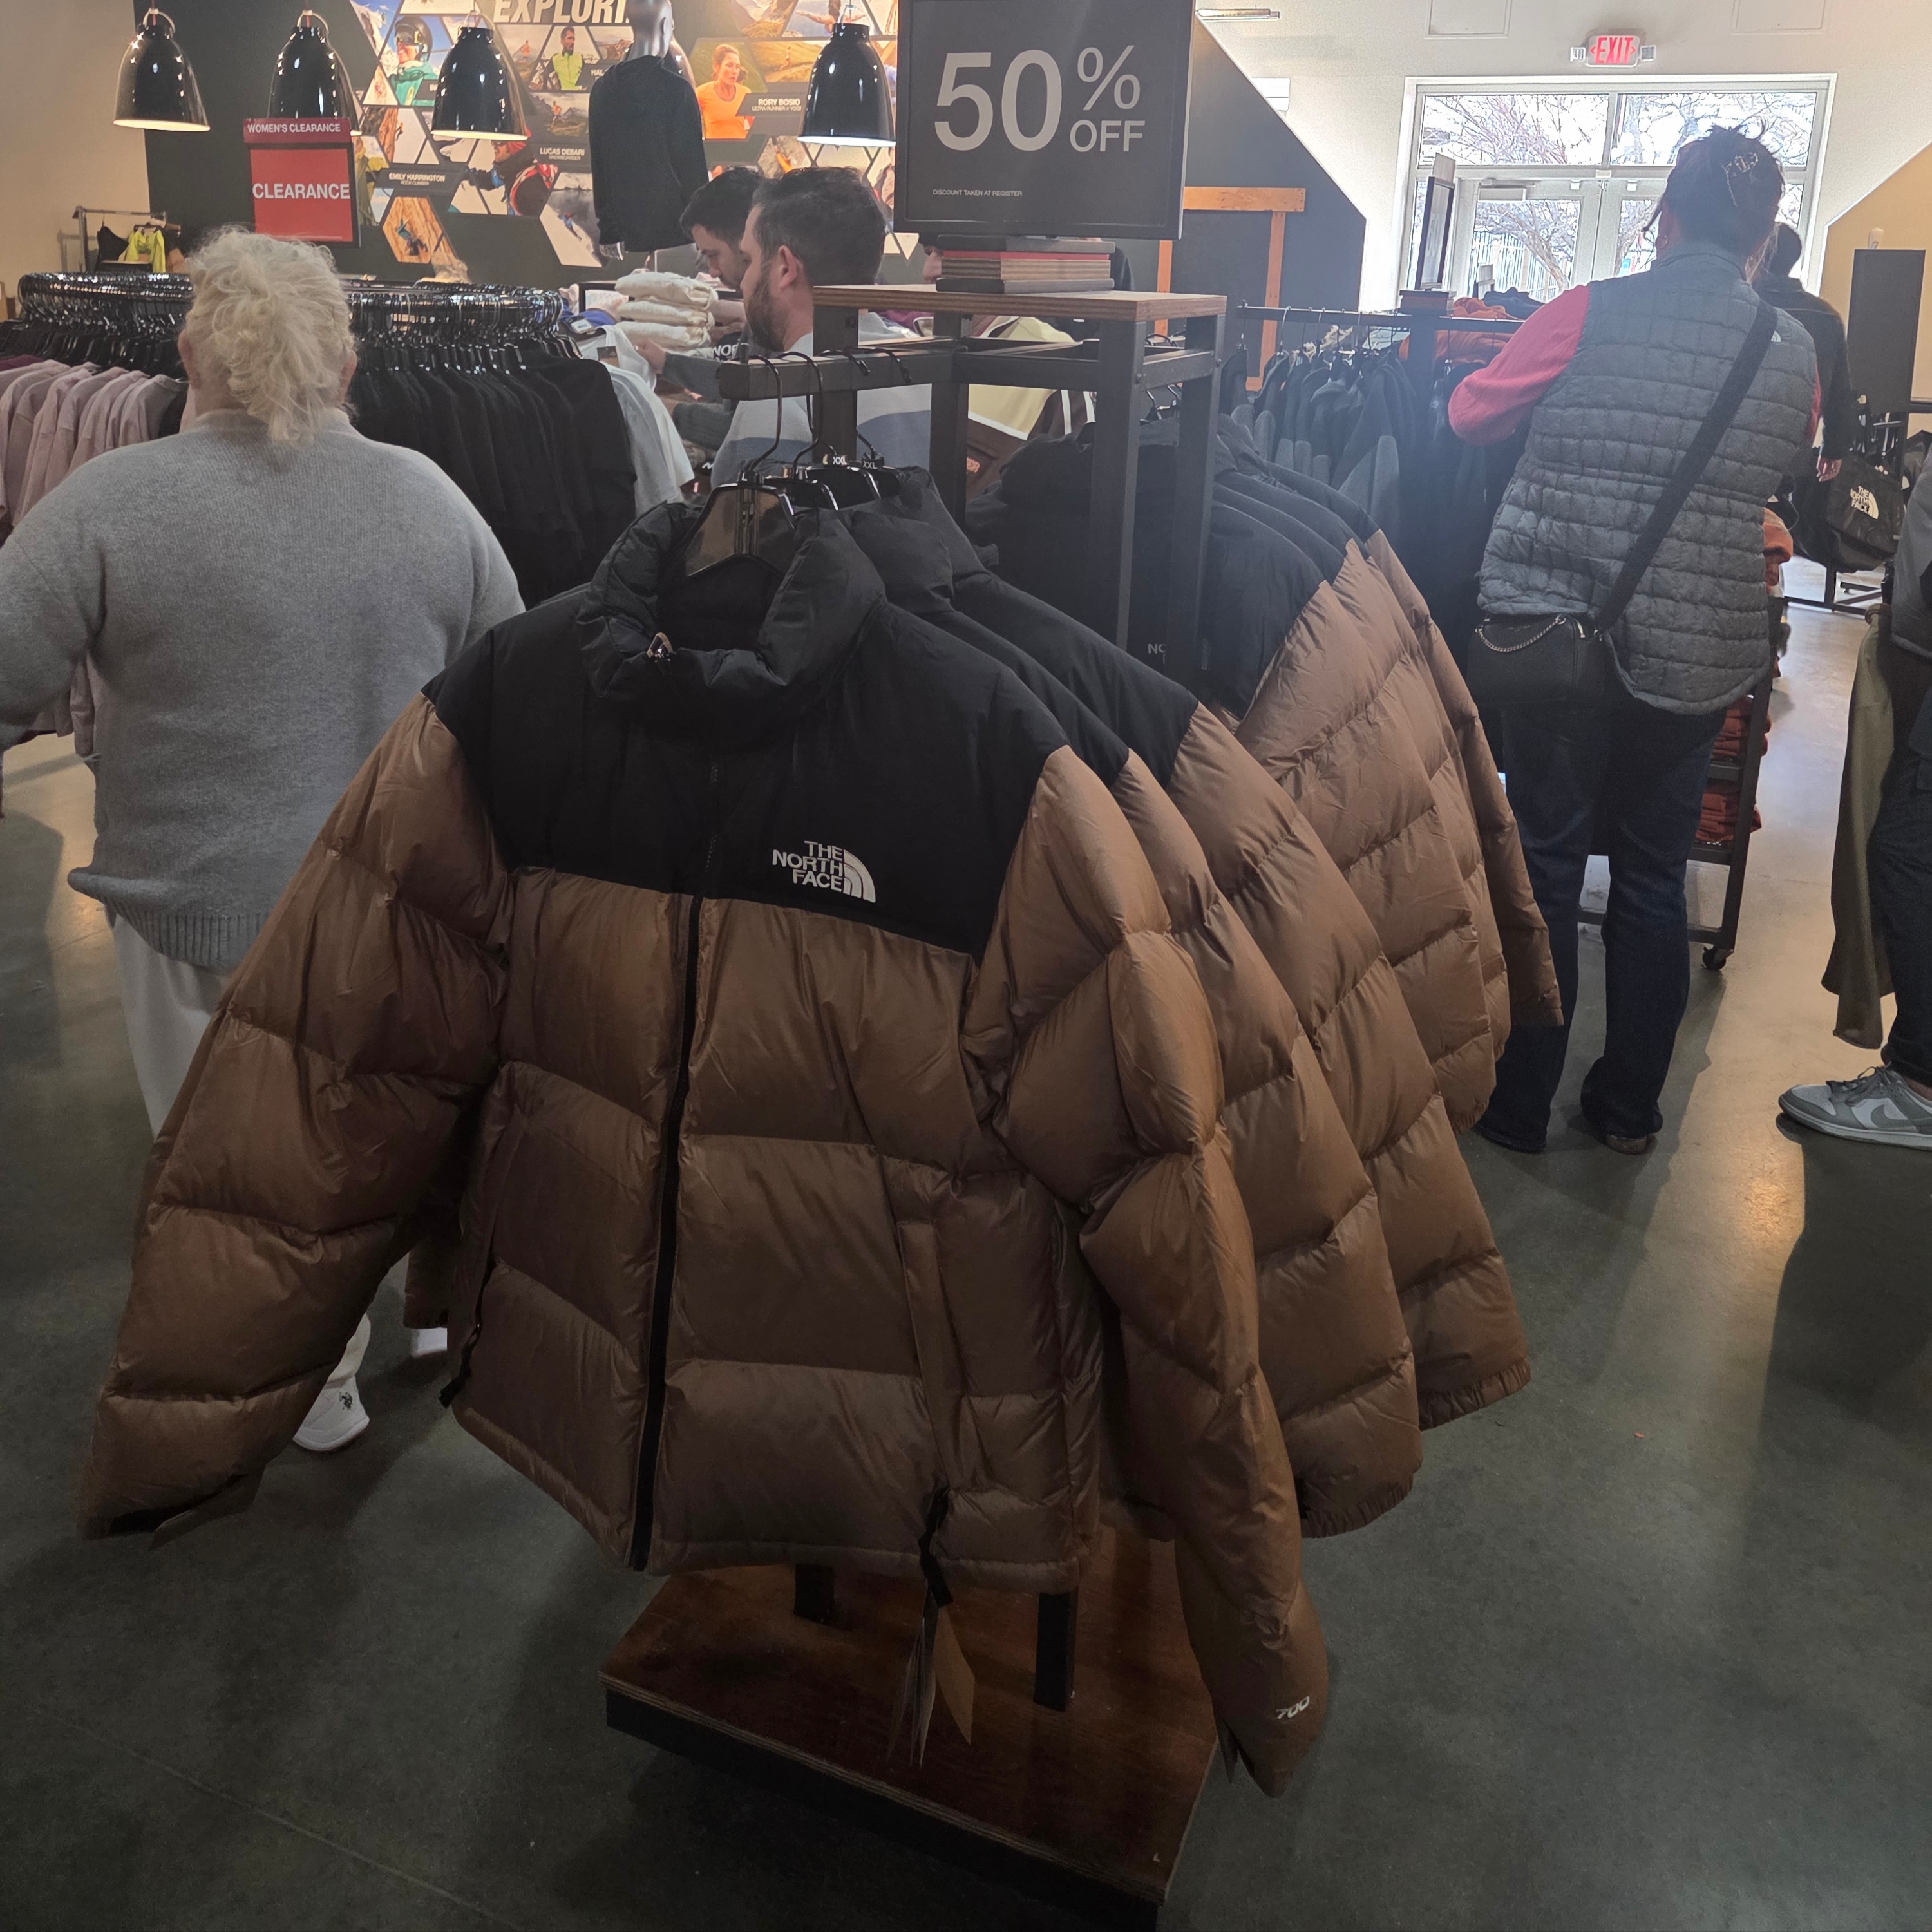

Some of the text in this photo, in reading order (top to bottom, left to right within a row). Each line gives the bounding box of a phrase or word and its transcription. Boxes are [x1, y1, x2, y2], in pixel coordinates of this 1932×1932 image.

[493, 0, 629, 23] EXPLORI
[1595, 36, 1634, 64] EXIT
[247, 123, 341, 133] WOMEN'S CLEARANCE
[1070, 120, 1145, 152] OFF
[406, 173, 446, 182] HARRINGTON
[252, 183, 350, 200] CLEARANCE
[833, 456, 848, 466] XXL
[863, 460, 878, 469] XXL
[1858, 486, 1869, 498] THE
[804, 840, 843, 862] THE
[772, 849, 843, 877] NORTH
[792, 869, 843, 893] FACE
[1276, 1696, 1310, 1719] 700
